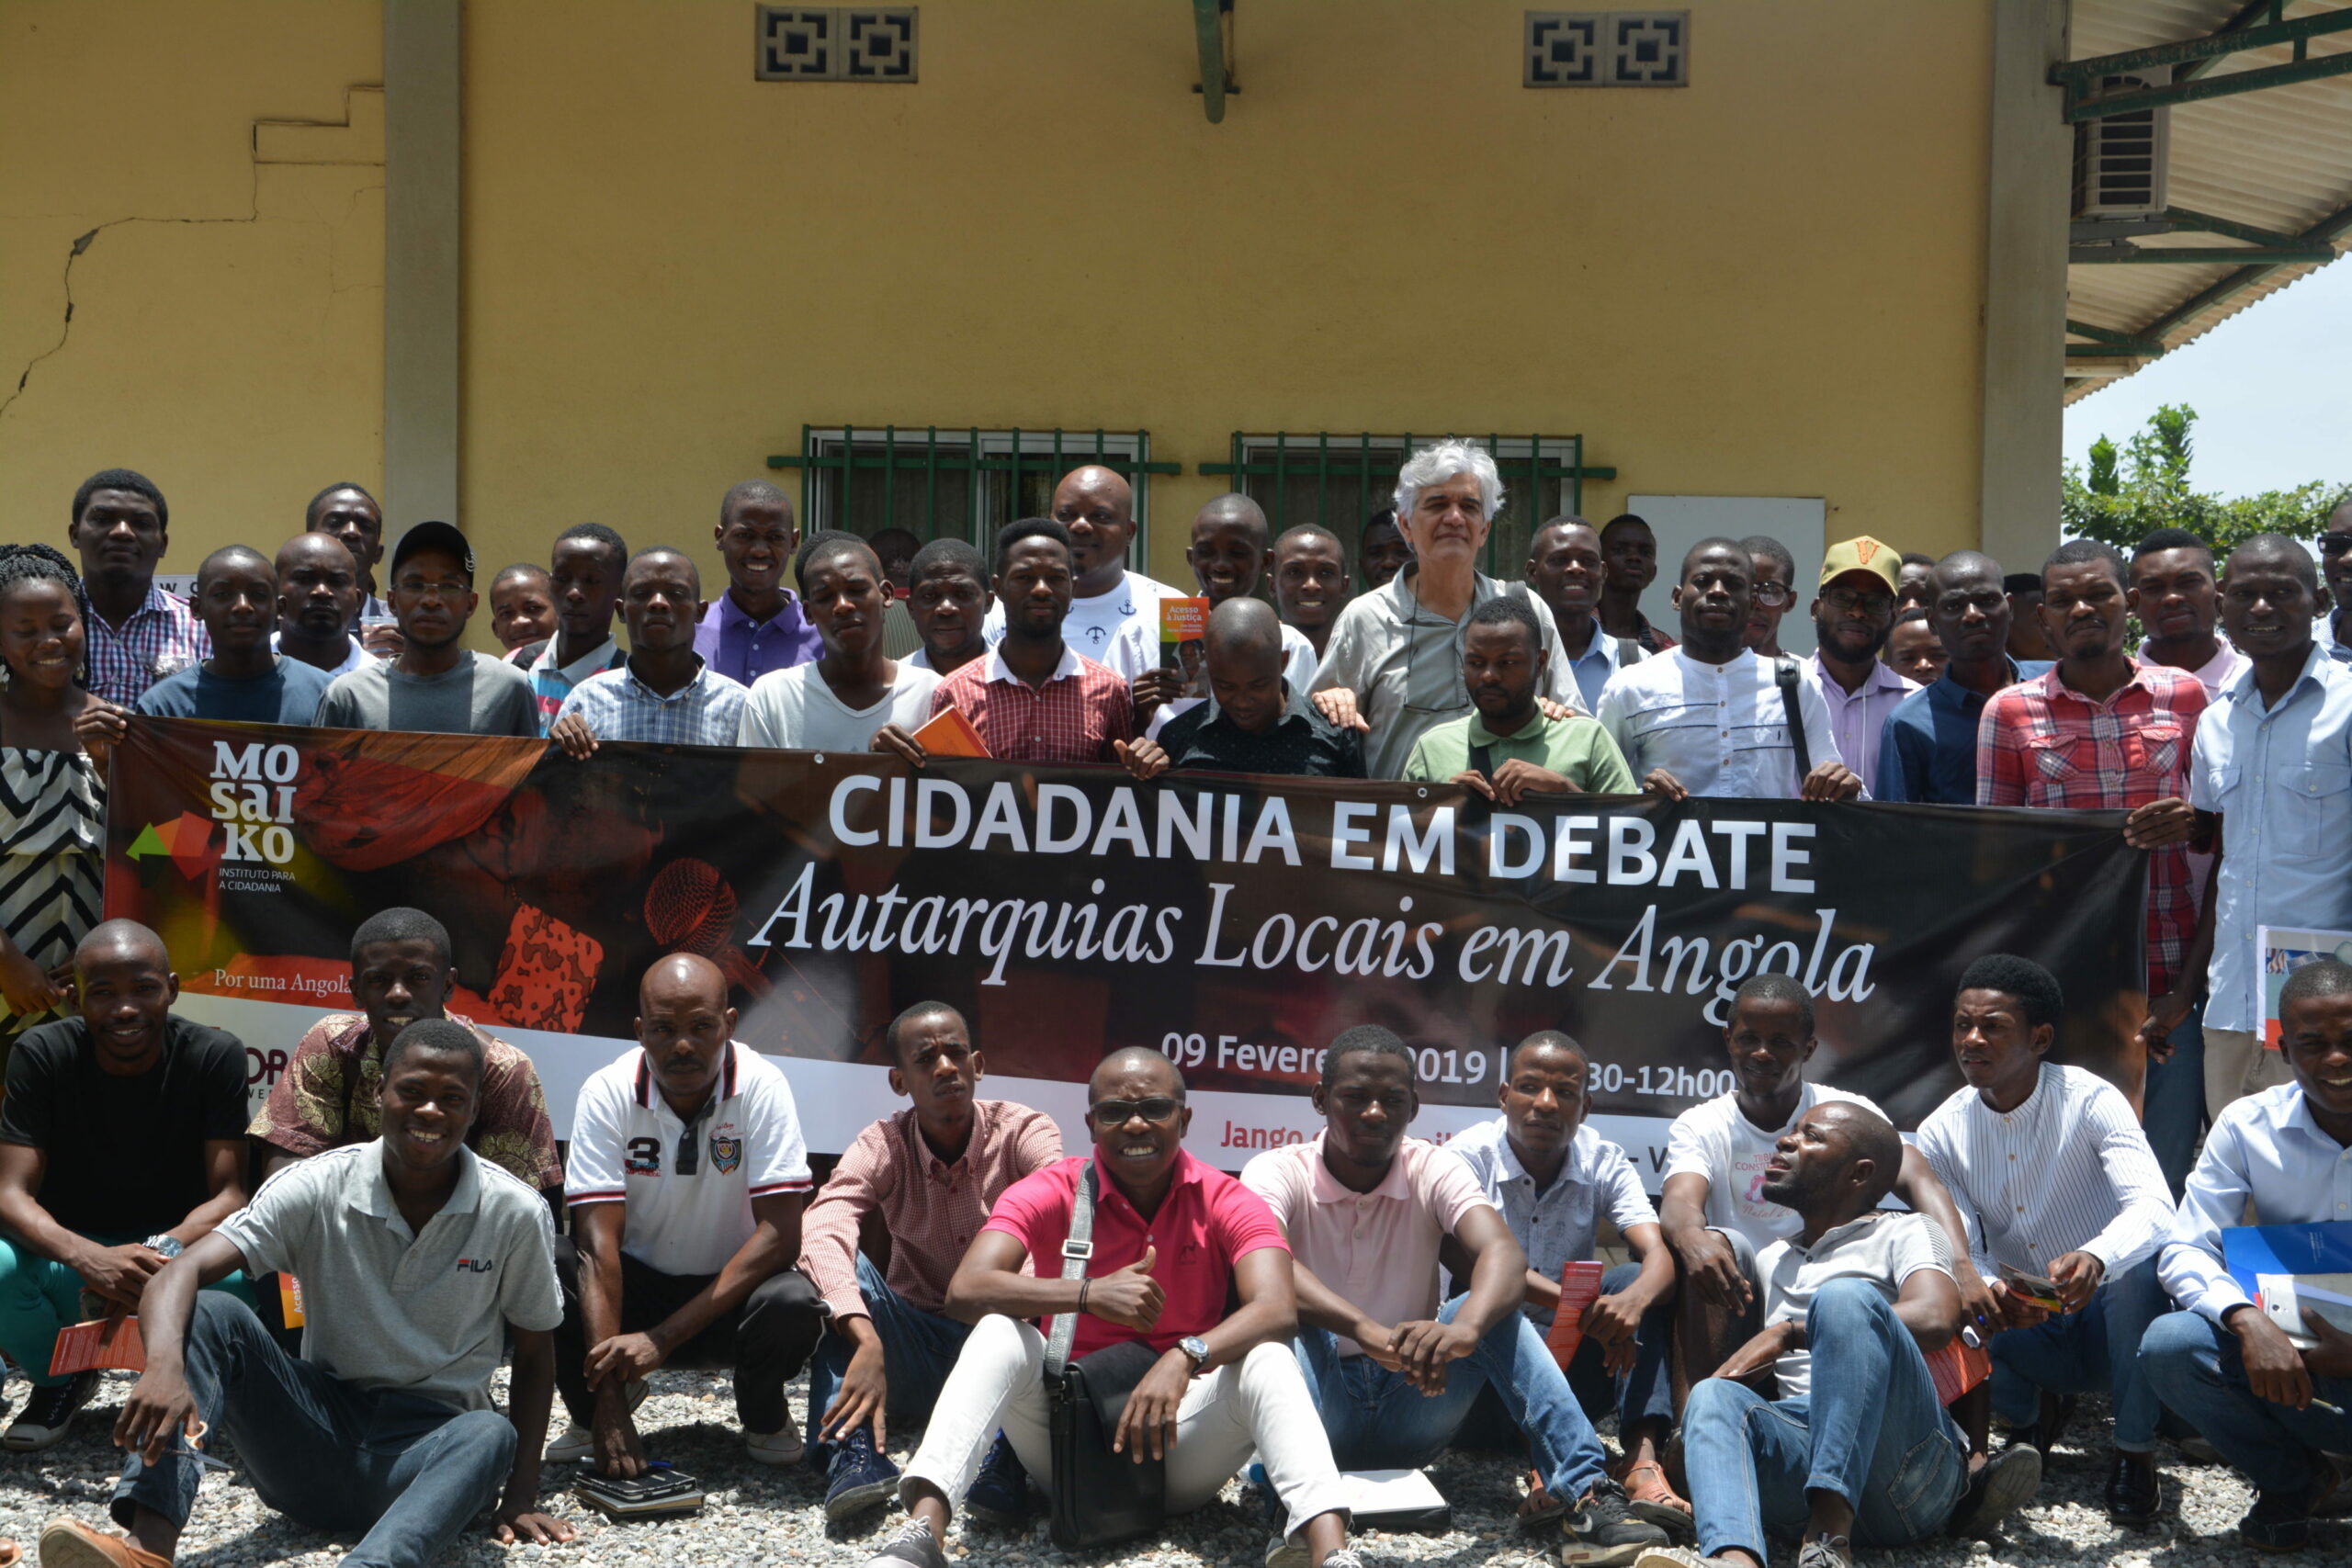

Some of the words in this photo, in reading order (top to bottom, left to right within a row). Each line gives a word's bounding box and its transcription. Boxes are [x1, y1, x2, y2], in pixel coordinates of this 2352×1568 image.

[209, 740, 300, 783] MO
[220, 822, 295, 864] KO
[829, 774, 1302, 866] CIDADANIA
[1330, 801, 1454, 875] EM
[1488, 812, 1816, 893] DEBATE
[219, 867, 269, 880] INSTITUTO
[271, 871, 295, 882] PARA
[219, 881, 226, 890] A
[228, 881, 281, 893] CIDADANIA
[747, 862, 1182, 986] Autarquias
[1195, 883, 1443, 979] Locais
[1459, 922, 1574, 987] em
[1588, 904, 1876, 1027] Angola
[214, 969, 244, 987] Por
[249, 975, 286, 990] uma
[290, 973, 352, 998] Angola
[1161, 1032, 1206, 1067] 09
[1220, 1120, 1303, 1149] Jango
[628, 1137, 660, 1167] 3
[457, 1258, 492, 1273] FILA
[291, 1277, 302, 1314] Acesso
